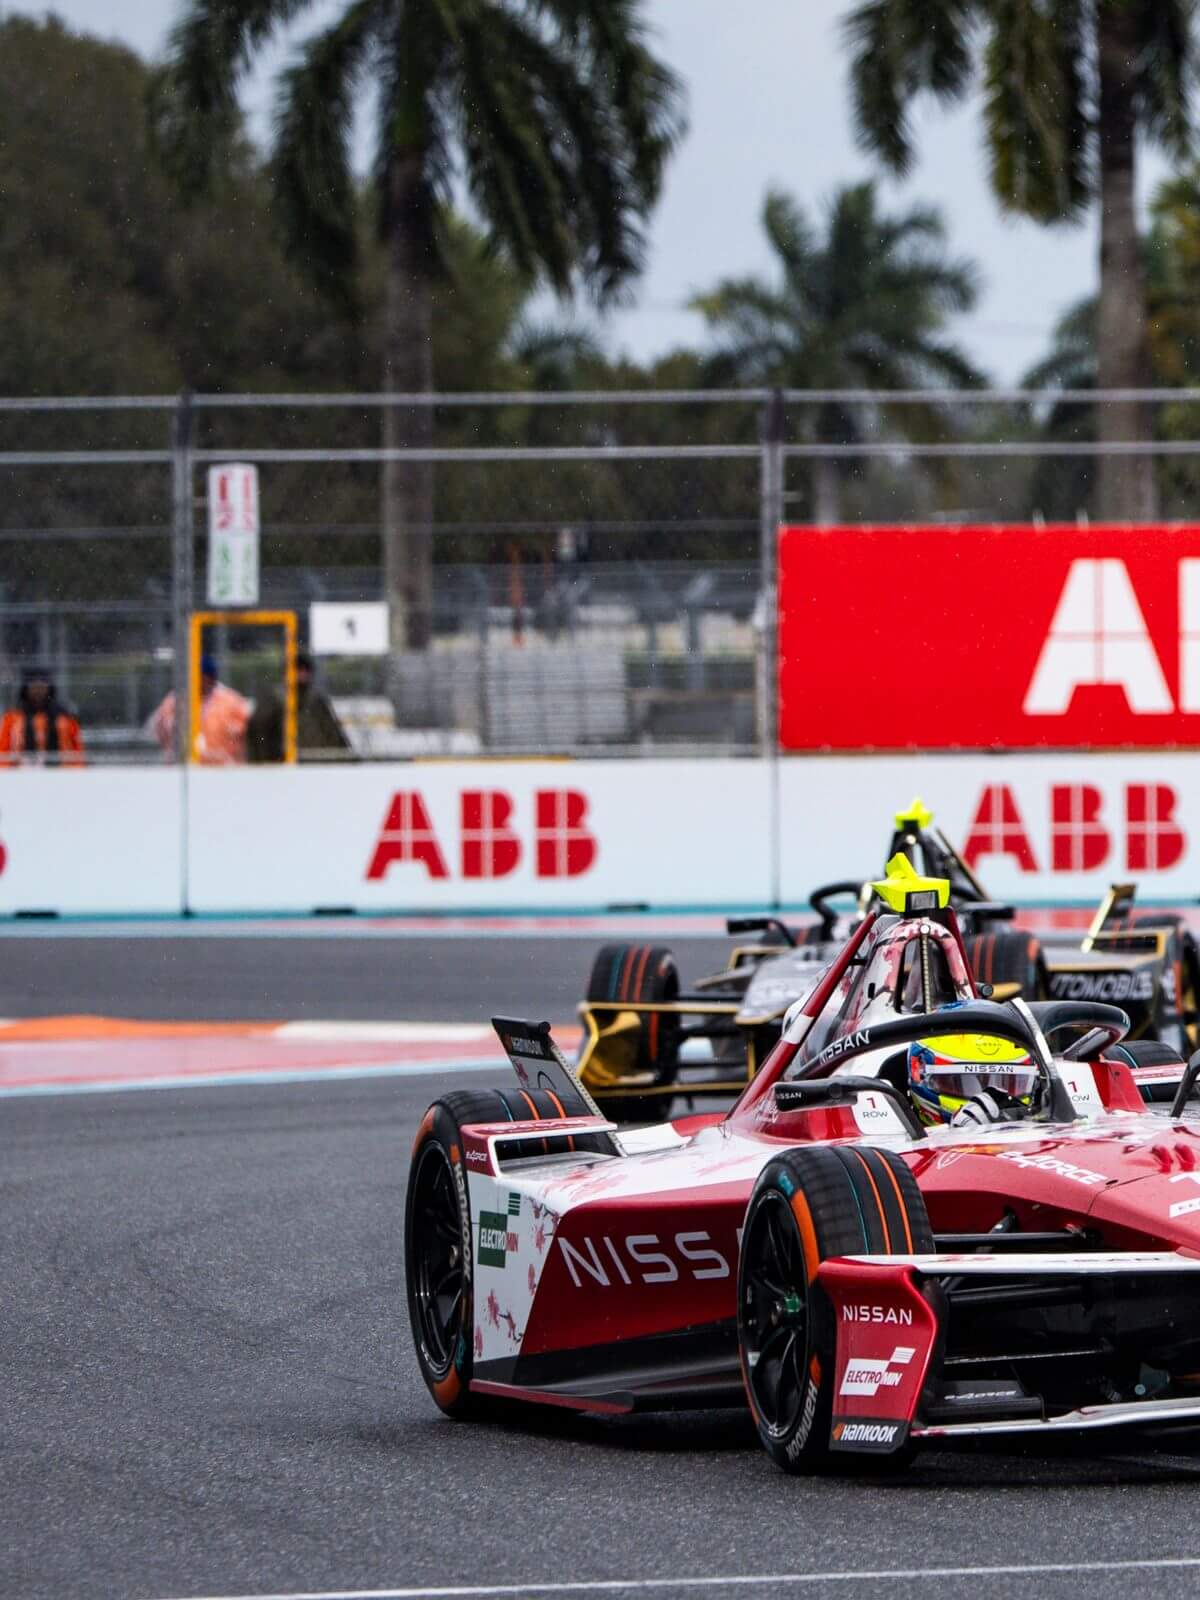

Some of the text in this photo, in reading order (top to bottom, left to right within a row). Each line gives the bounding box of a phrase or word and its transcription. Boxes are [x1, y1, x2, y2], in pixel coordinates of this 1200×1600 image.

[366, 789, 598, 881] ABB
[961, 783, 1187, 873] ABB
[819, 1030, 869, 1065] NISSAN
[963, 1064, 1014, 1074] NISSAN
[862, 1110, 888, 1119] ROW
[866, 1096, 876, 1109] 1
[557, 1228, 743, 1287] NISS
[842, 1304, 913, 1326] NISSAN
